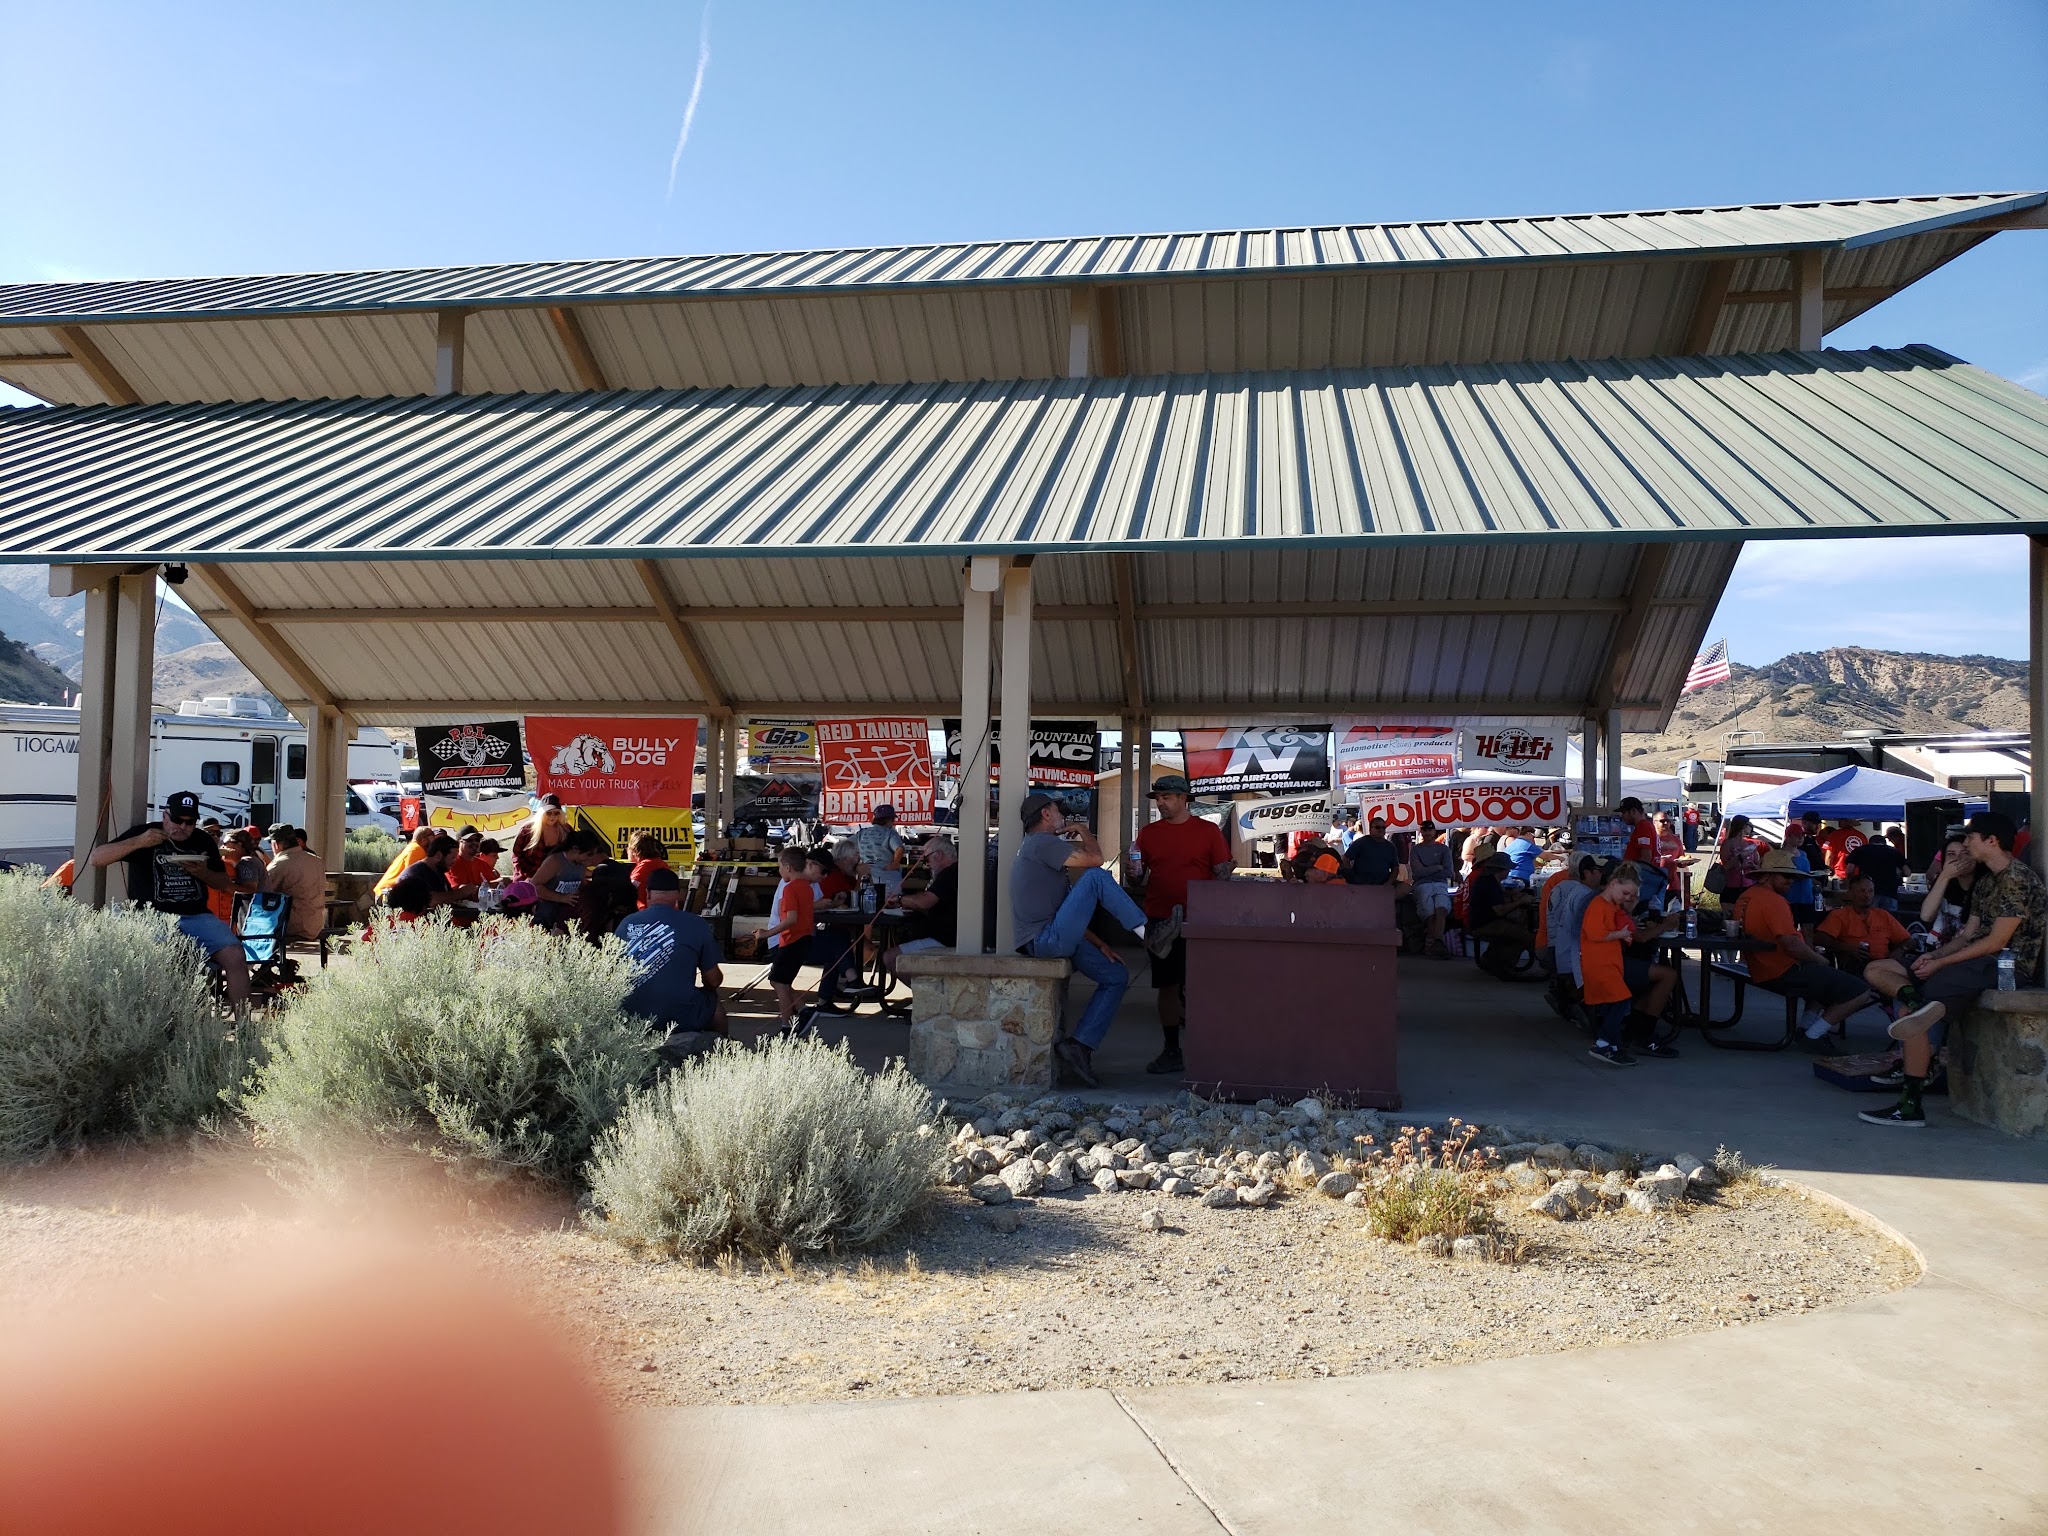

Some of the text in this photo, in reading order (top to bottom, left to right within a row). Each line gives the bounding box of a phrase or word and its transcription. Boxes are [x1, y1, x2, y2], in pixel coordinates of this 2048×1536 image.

[448, 725, 487, 742] P.C.I.
[818, 722, 927, 740] RED TANDEM
[1340, 725, 1454, 744] ARP
[14, 736, 66, 753] TIOGA
[612, 737, 680, 751] BULLY
[1340, 742, 1389, 754] automotive
[1413, 740, 1454, 748] products
[621, 751, 666, 765] DOG
[1343, 758, 1448, 772] THE WORLD LEADER IN
[438, 766, 509, 778] RACE RADIOS
[1343, 771, 1368, 780] RACING
[1368, 769, 1403, 778] FASTENER
[425, 777, 522, 791] WWW.PCIRACERADIOS.COM
[548, 779, 576, 789] MAKE
[579, 779, 606, 789] YOUR
[609, 779, 640, 790] TRUCK
[1190, 773, 1292, 787] SUPERIOR AIRFLOW.
[1190, 780, 1325, 794] SUPERIOR PERFORMANCE.
[757, 796, 767, 804] RT
[1432, 786, 1552, 800] DISC BRAKES
[825, 789, 933, 814] BREWERY
[1367, 785, 1561, 828] wilwood
